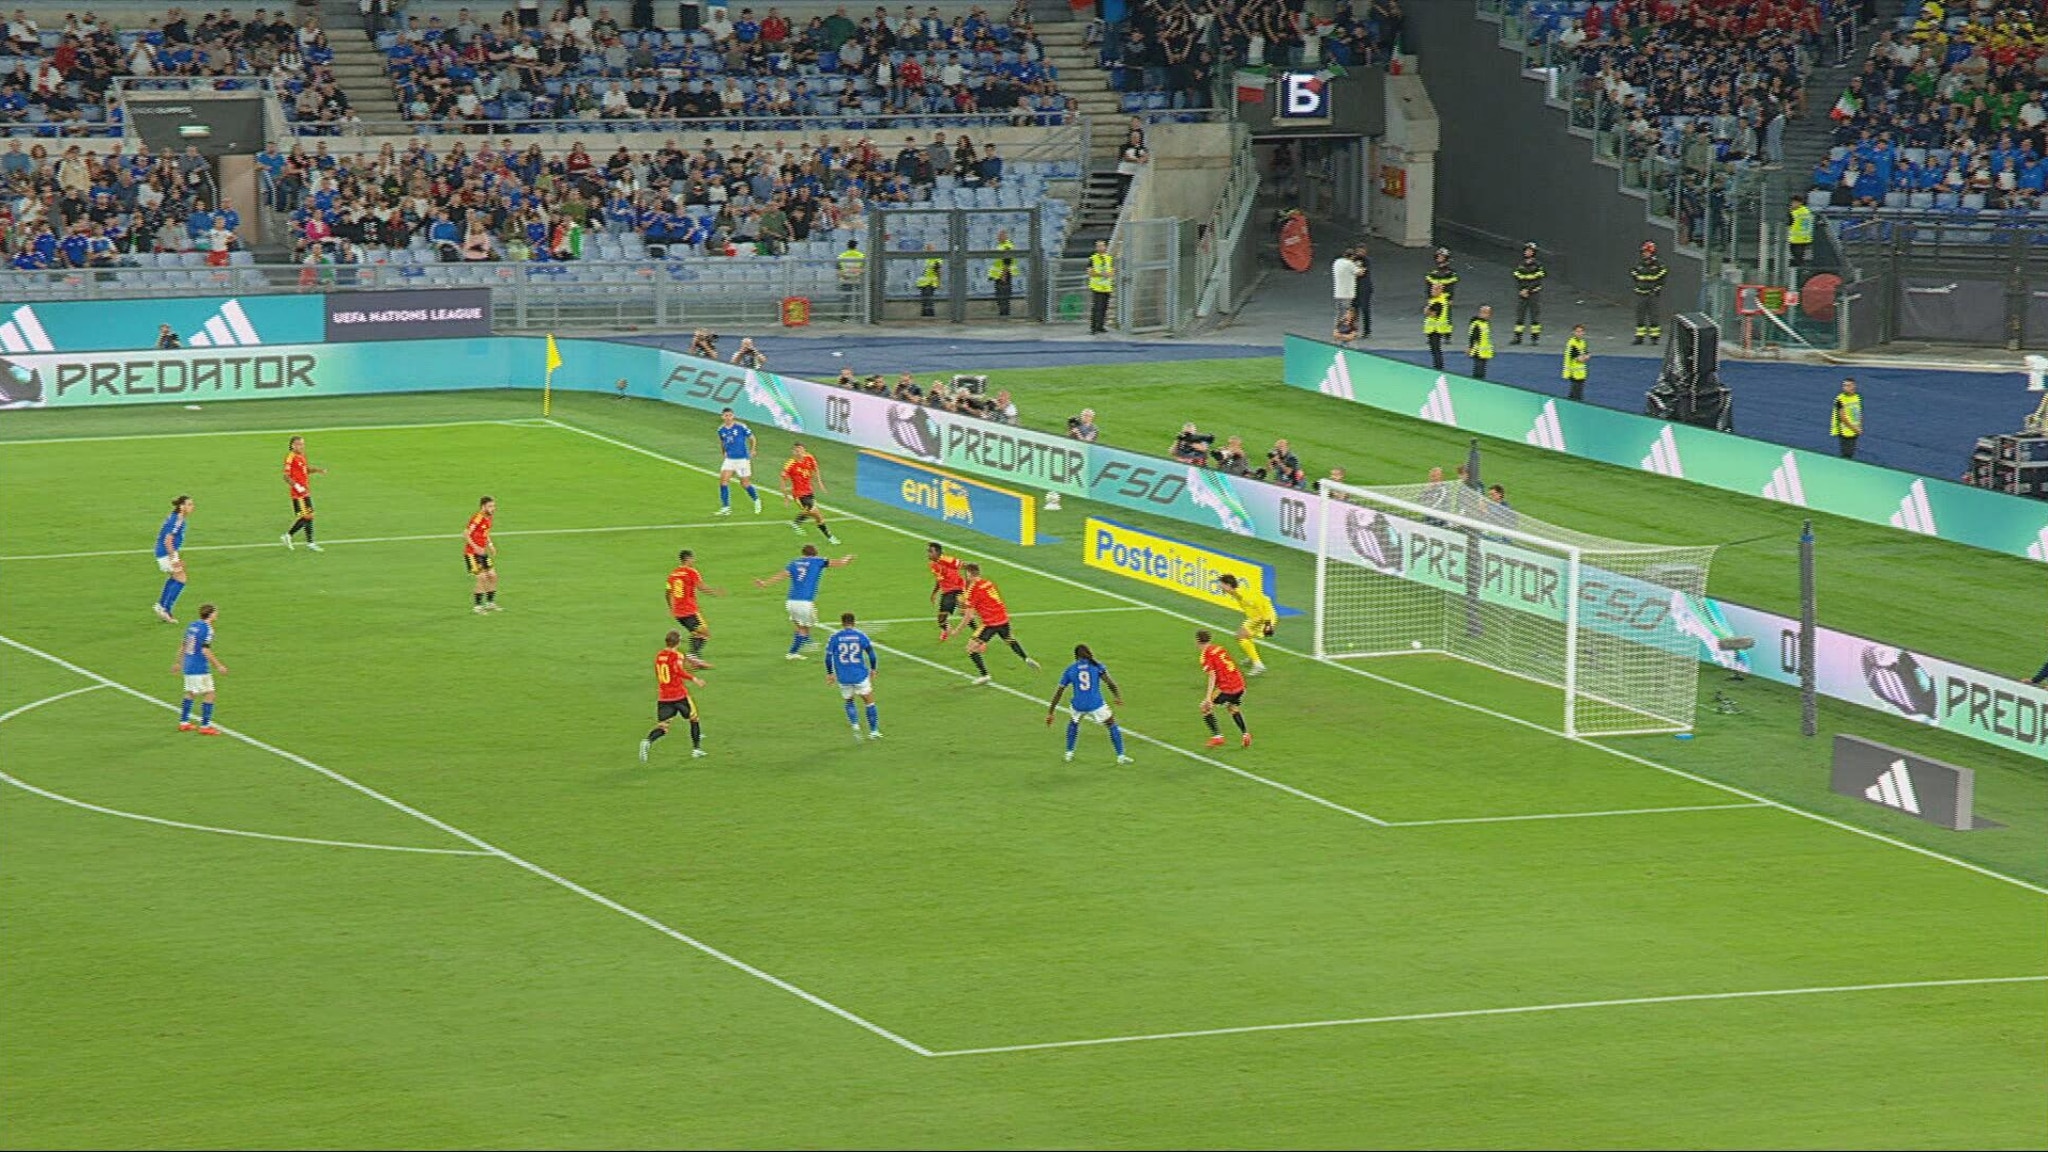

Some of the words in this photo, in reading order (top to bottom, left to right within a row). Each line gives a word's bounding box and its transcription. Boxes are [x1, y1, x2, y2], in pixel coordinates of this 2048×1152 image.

[333, 311, 367, 324] UEFA
[368, 309, 428, 322] NATIONS
[430, 307, 482, 321] LEAGUE
[57, 354, 316, 396] PREDATOR
[826, 395, 852, 434] OR
[949, 424, 1085, 488] PREDATOR
[902, 479, 938, 509] eni
[1280, 497, 1306, 541] OR
[1096, 529, 1250, 596] Posteitalia
[1411, 532, 1560, 610] PREATOR
[838, 642, 860, 663] 22
[656, 663, 671, 684] 10
[1079, 671, 1091, 691] 9
